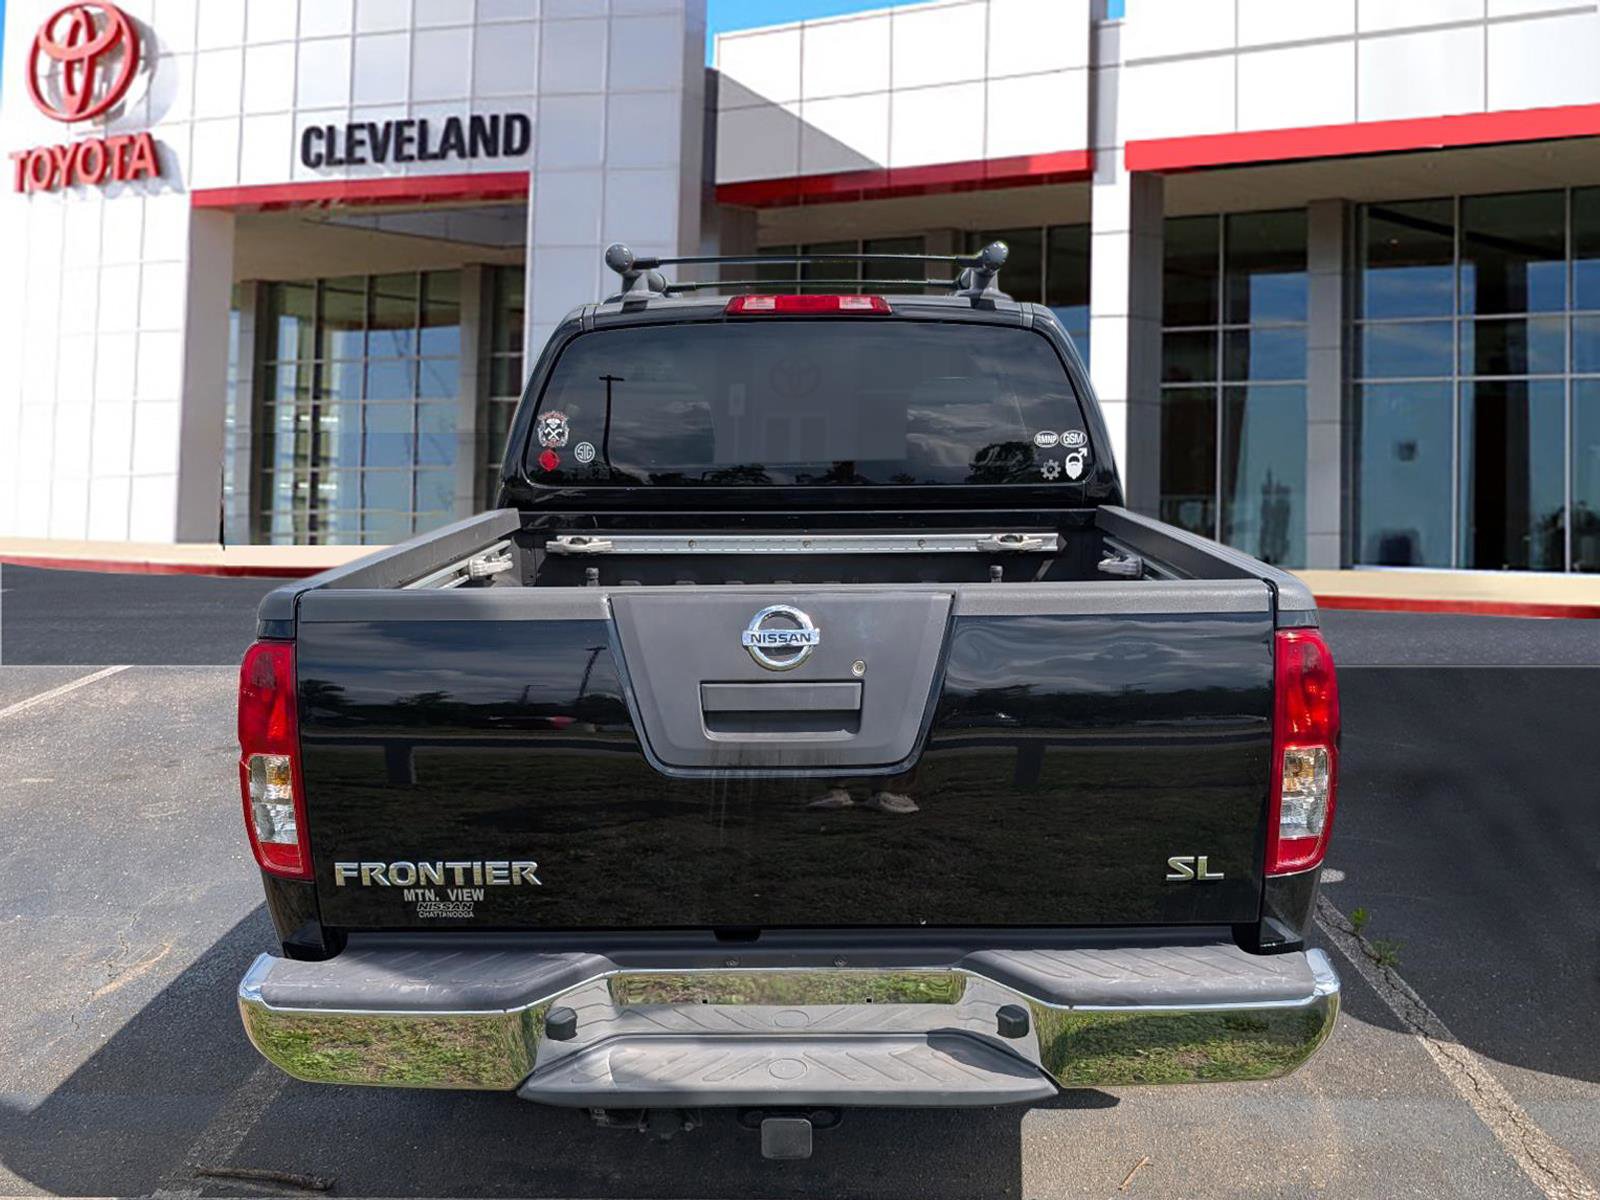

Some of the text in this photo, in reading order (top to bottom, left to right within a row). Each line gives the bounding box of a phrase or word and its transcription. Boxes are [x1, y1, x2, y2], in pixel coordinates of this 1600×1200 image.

[301, 114, 531, 168] CLEVELAND
[9, 131, 159, 193] TOYOTA
[1063, 433, 1083, 444] GSM
[578, 445, 592, 460] SIG
[750, 633, 811, 643] NISSAN
[334, 861, 542, 886] FRONTIER
[1166, 856, 1224, 880] SL
[403, 888, 485, 901] MTN. VIEW
[416, 901, 474, 911] NISSAN
[418, 910, 474, 918] CHATTANOOGA
